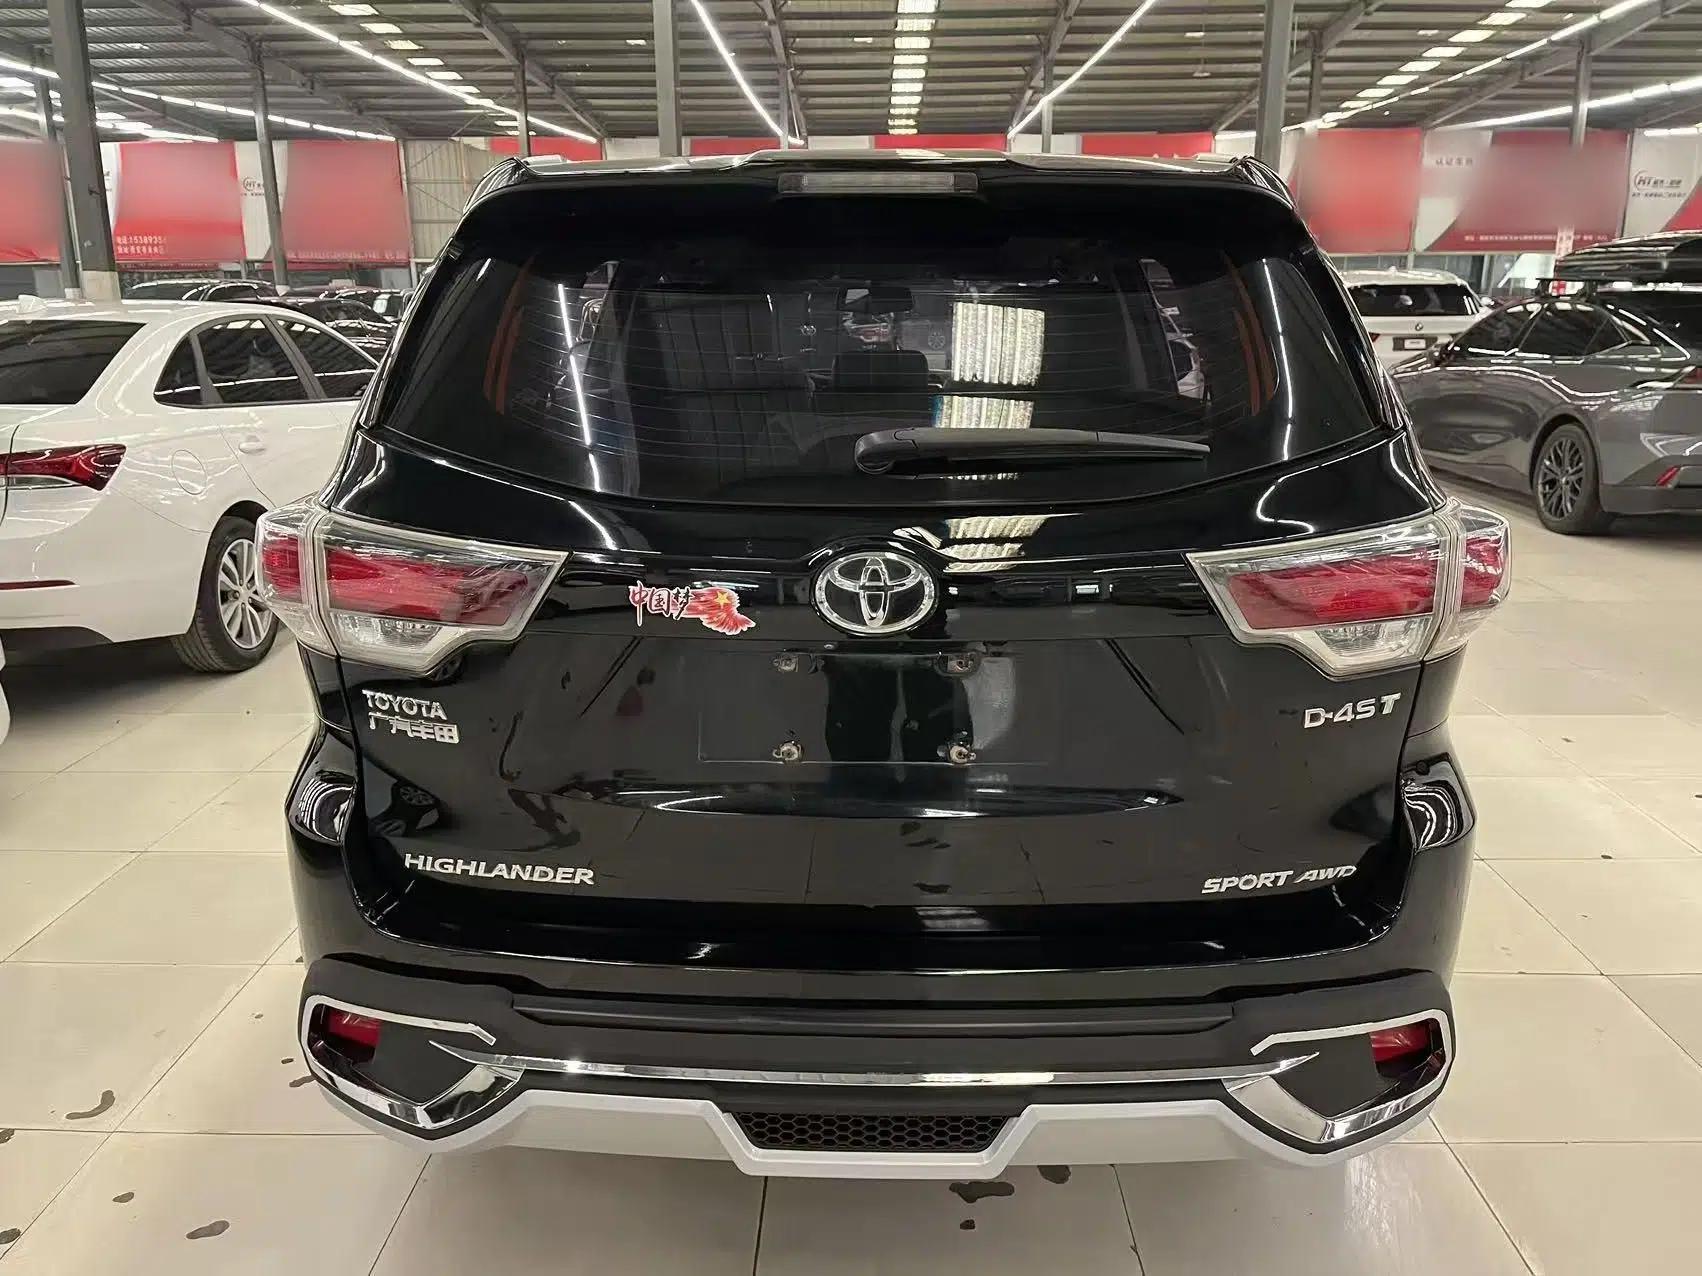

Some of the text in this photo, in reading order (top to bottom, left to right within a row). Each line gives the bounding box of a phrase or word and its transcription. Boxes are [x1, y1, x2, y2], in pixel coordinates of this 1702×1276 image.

[628, 580, 695, 626] 中国梦
[361, 689, 448, 721] TOYOTA
[367, 711, 460, 744] 广汽丰田
[404, 853, 595, 885] HIGHLANDER
[1201, 865, 1357, 894] SPORT AWD
